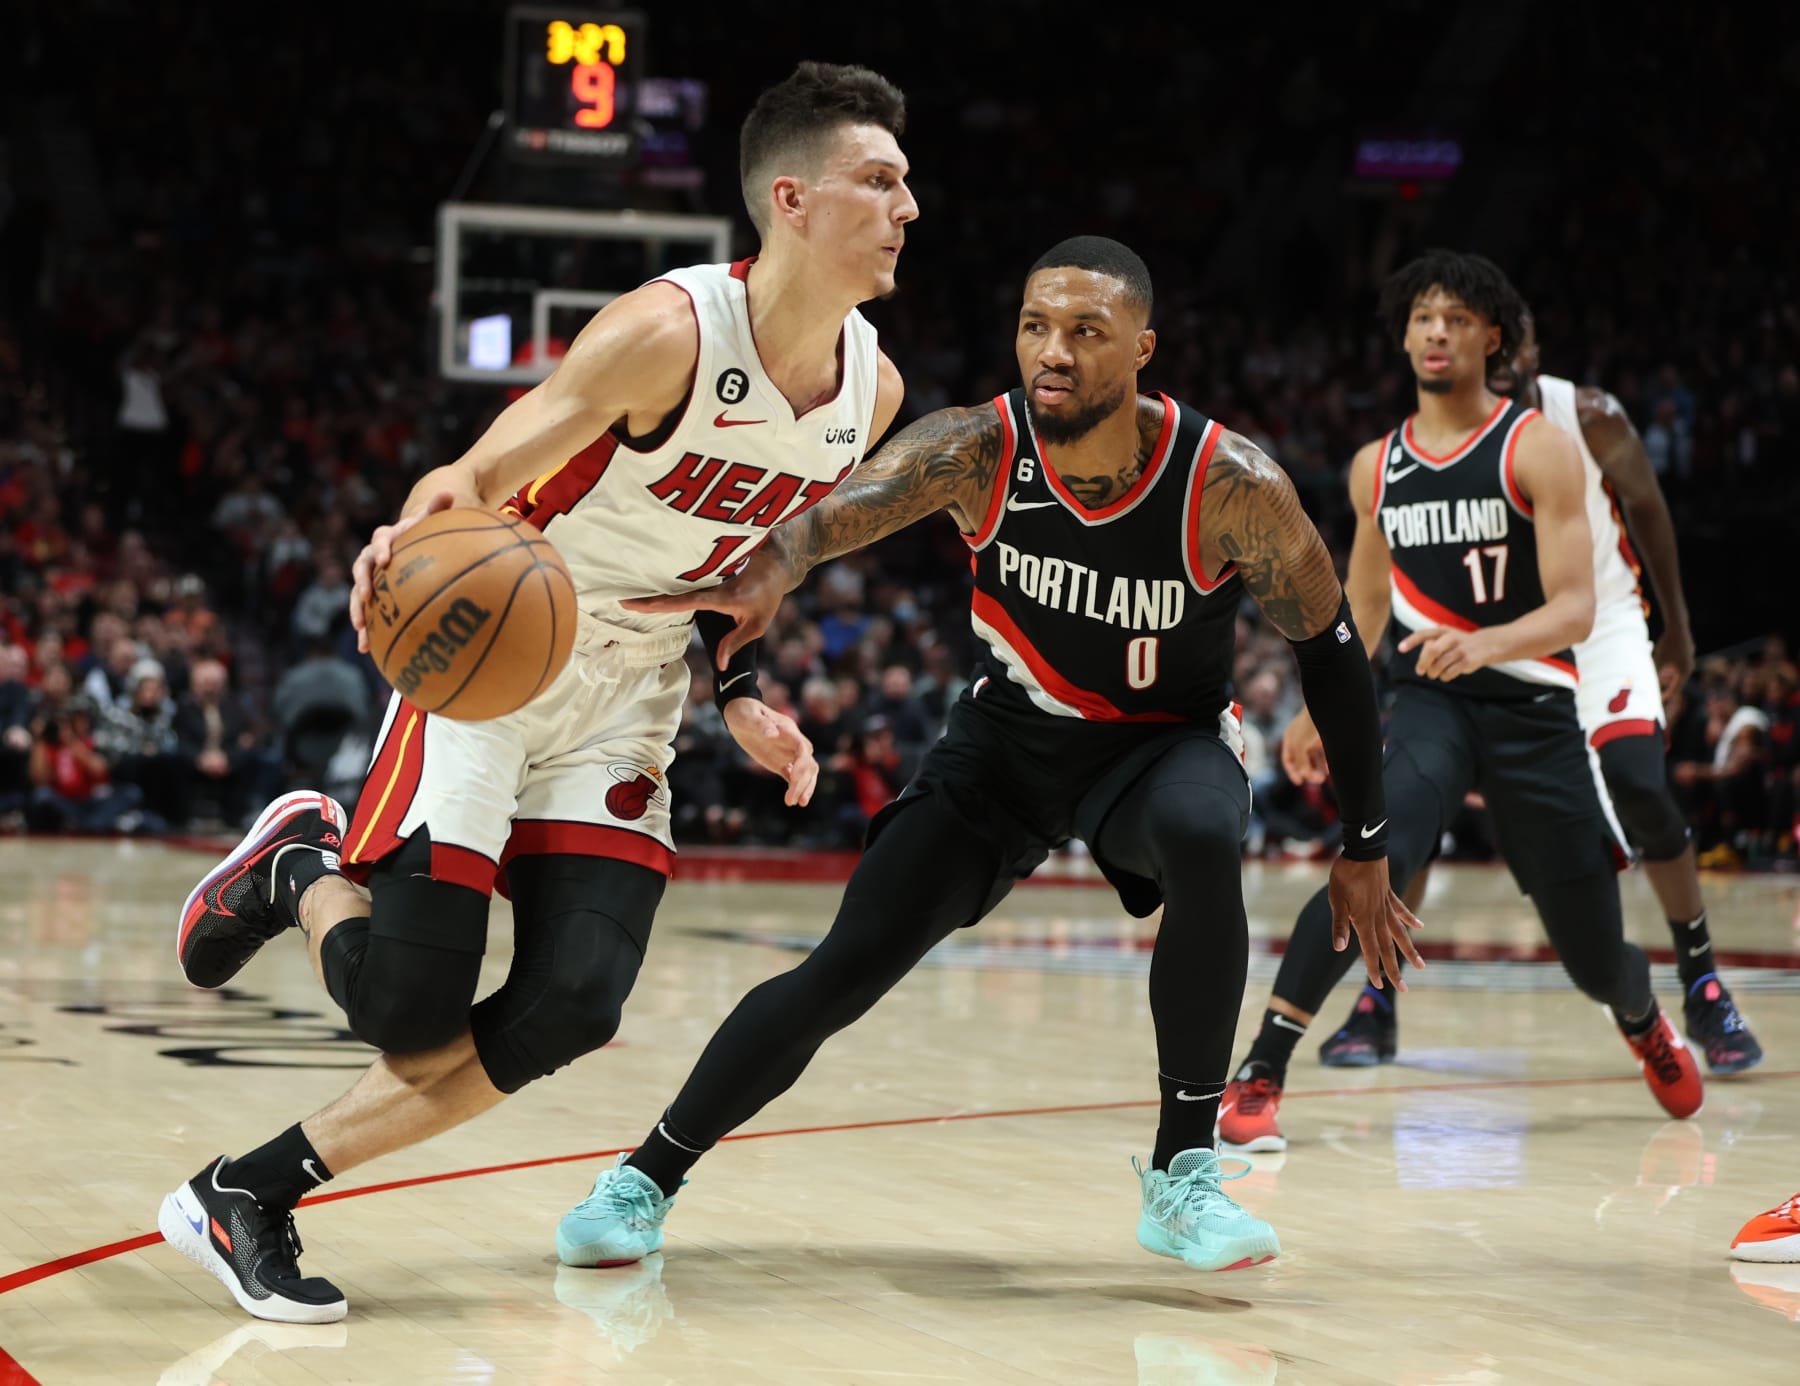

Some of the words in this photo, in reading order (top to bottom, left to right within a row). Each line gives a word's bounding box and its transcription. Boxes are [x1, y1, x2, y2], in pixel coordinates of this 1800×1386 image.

[571, 61, 616, 128] 9
[722, 373, 743, 401] 6
[1017, 458, 1035, 482] 6
[1381, 497, 1509, 549] PORTLAND
[995, 540, 1186, 631] PORTLAND
[1462, 544, 1509, 604] 17
[394, 597, 492, 697] Wilson
[1127, 636, 1159, 691] 0
